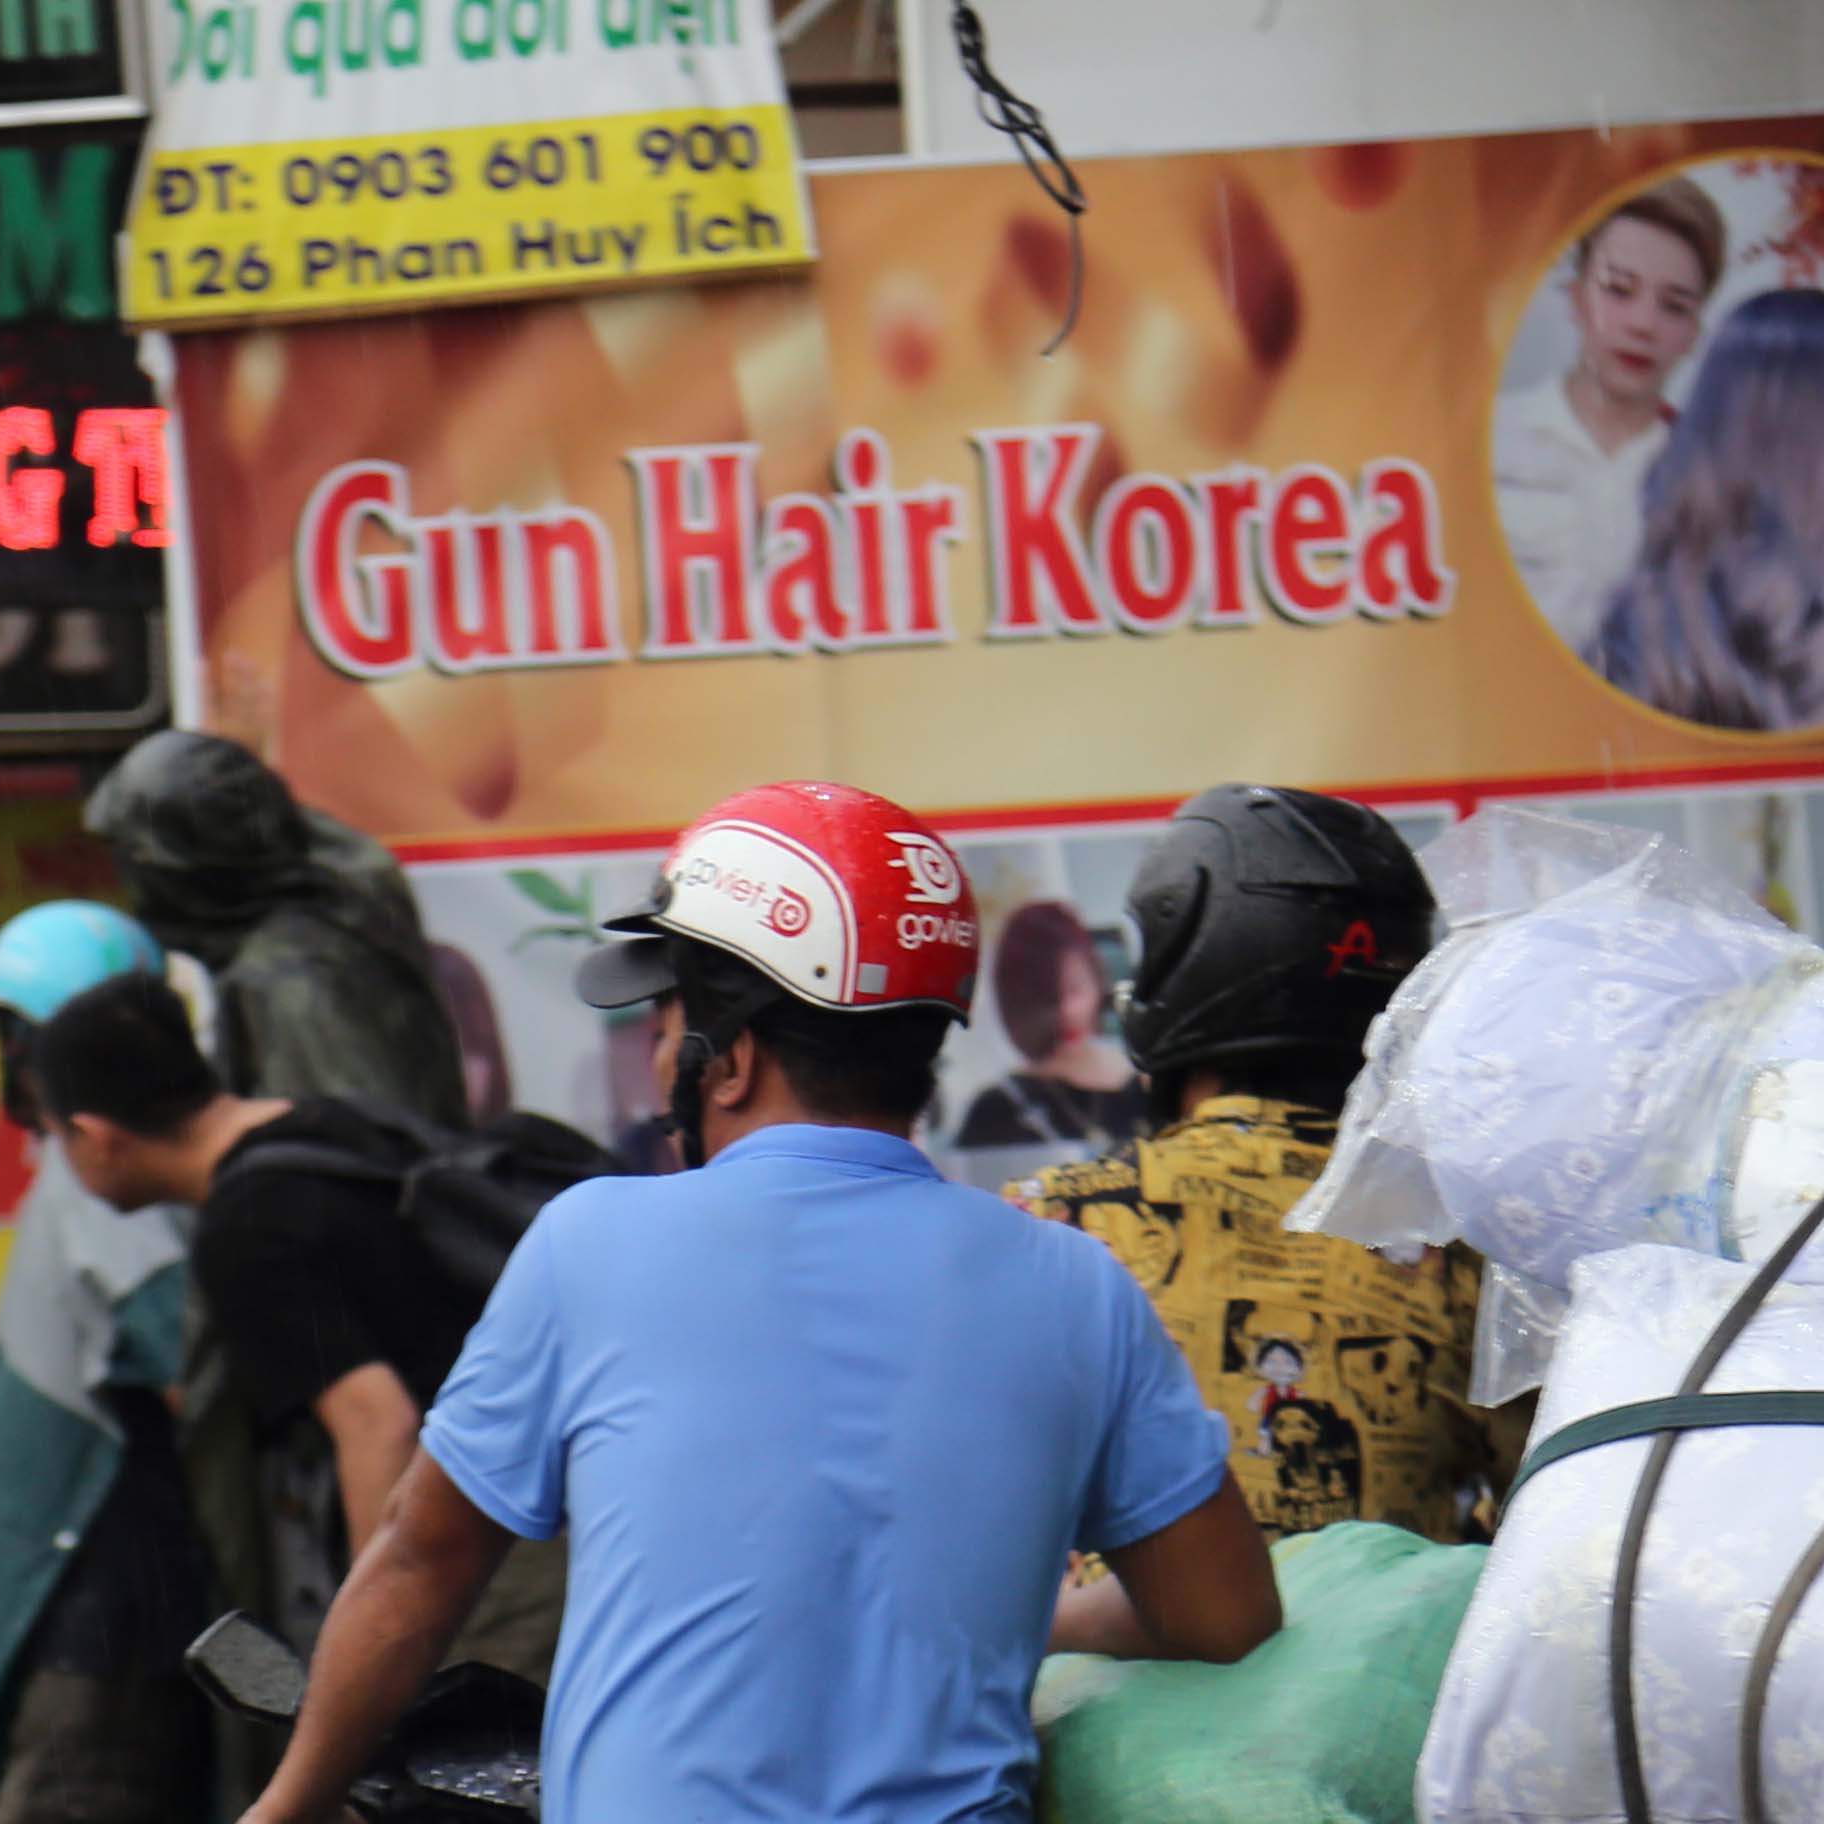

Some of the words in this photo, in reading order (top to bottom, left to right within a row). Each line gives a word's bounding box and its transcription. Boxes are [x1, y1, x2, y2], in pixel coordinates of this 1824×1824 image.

[284, 147, 453, 206] 0903
[485, 133, 601, 191] 601
[637, 123, 761, 177] 900
[150, 243, 274, 300] 126
[301, 238, 482, 288] Phan
[511, 220, 647, 276] Huy
[299, 462, 620, 678] Gun
[630, 432, 962, 660] Hair
[976, 423, 1452, 642] Korea
[895, 911, 977, 951] govie
